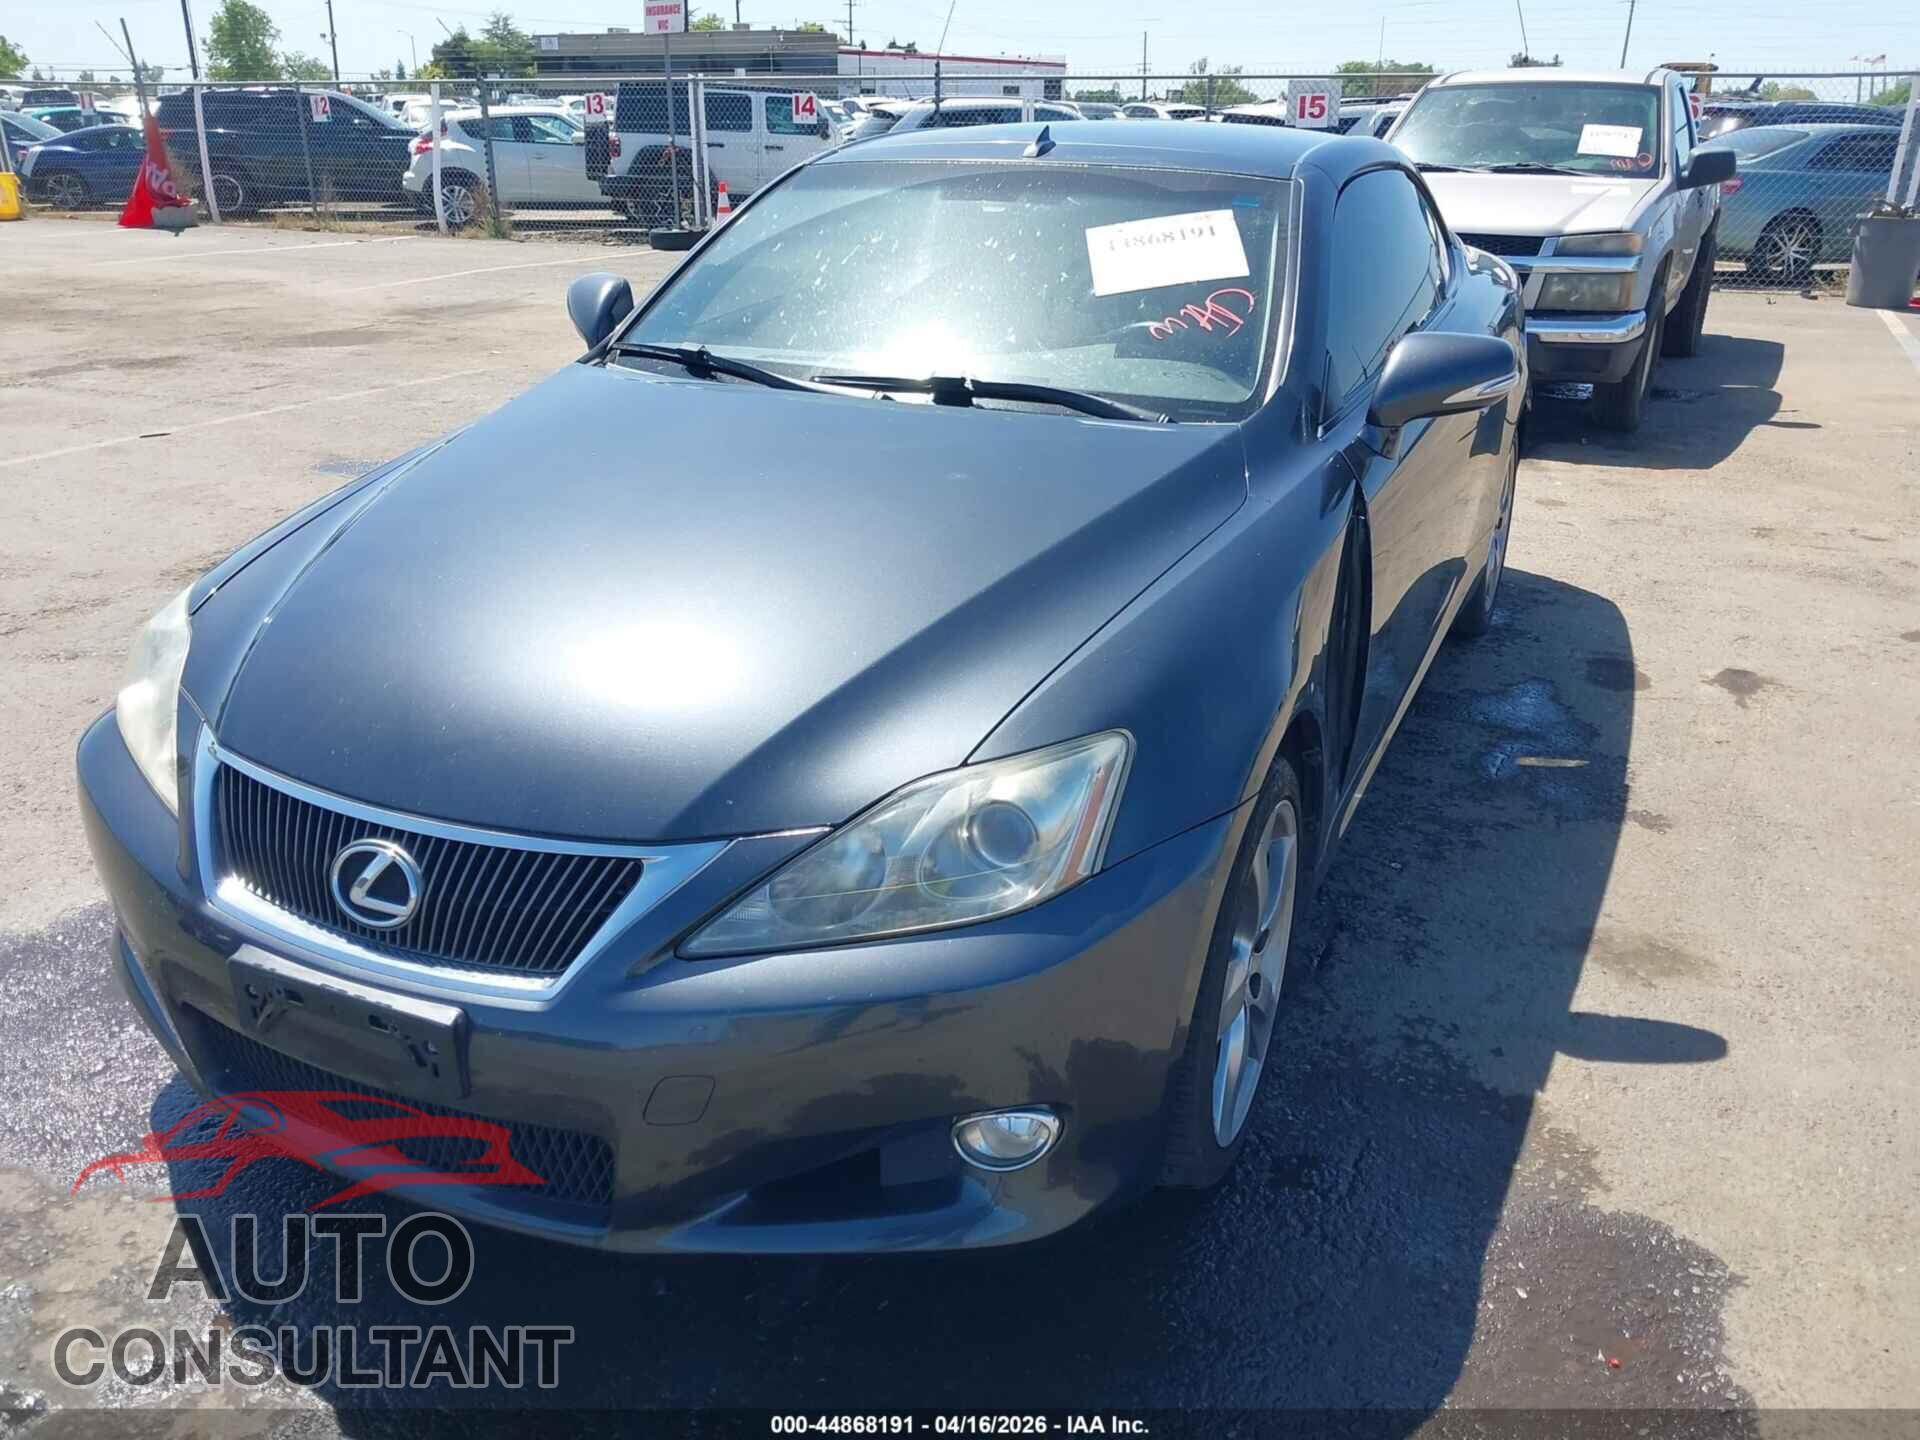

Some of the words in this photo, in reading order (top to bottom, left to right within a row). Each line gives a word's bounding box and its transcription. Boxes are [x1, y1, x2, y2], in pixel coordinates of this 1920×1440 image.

[314, 96, 329, 114] 12
[586, 94, 604, 115] 13
[794, 95, 816, 116] 14
[1298, 95, 1326, 120] 15
